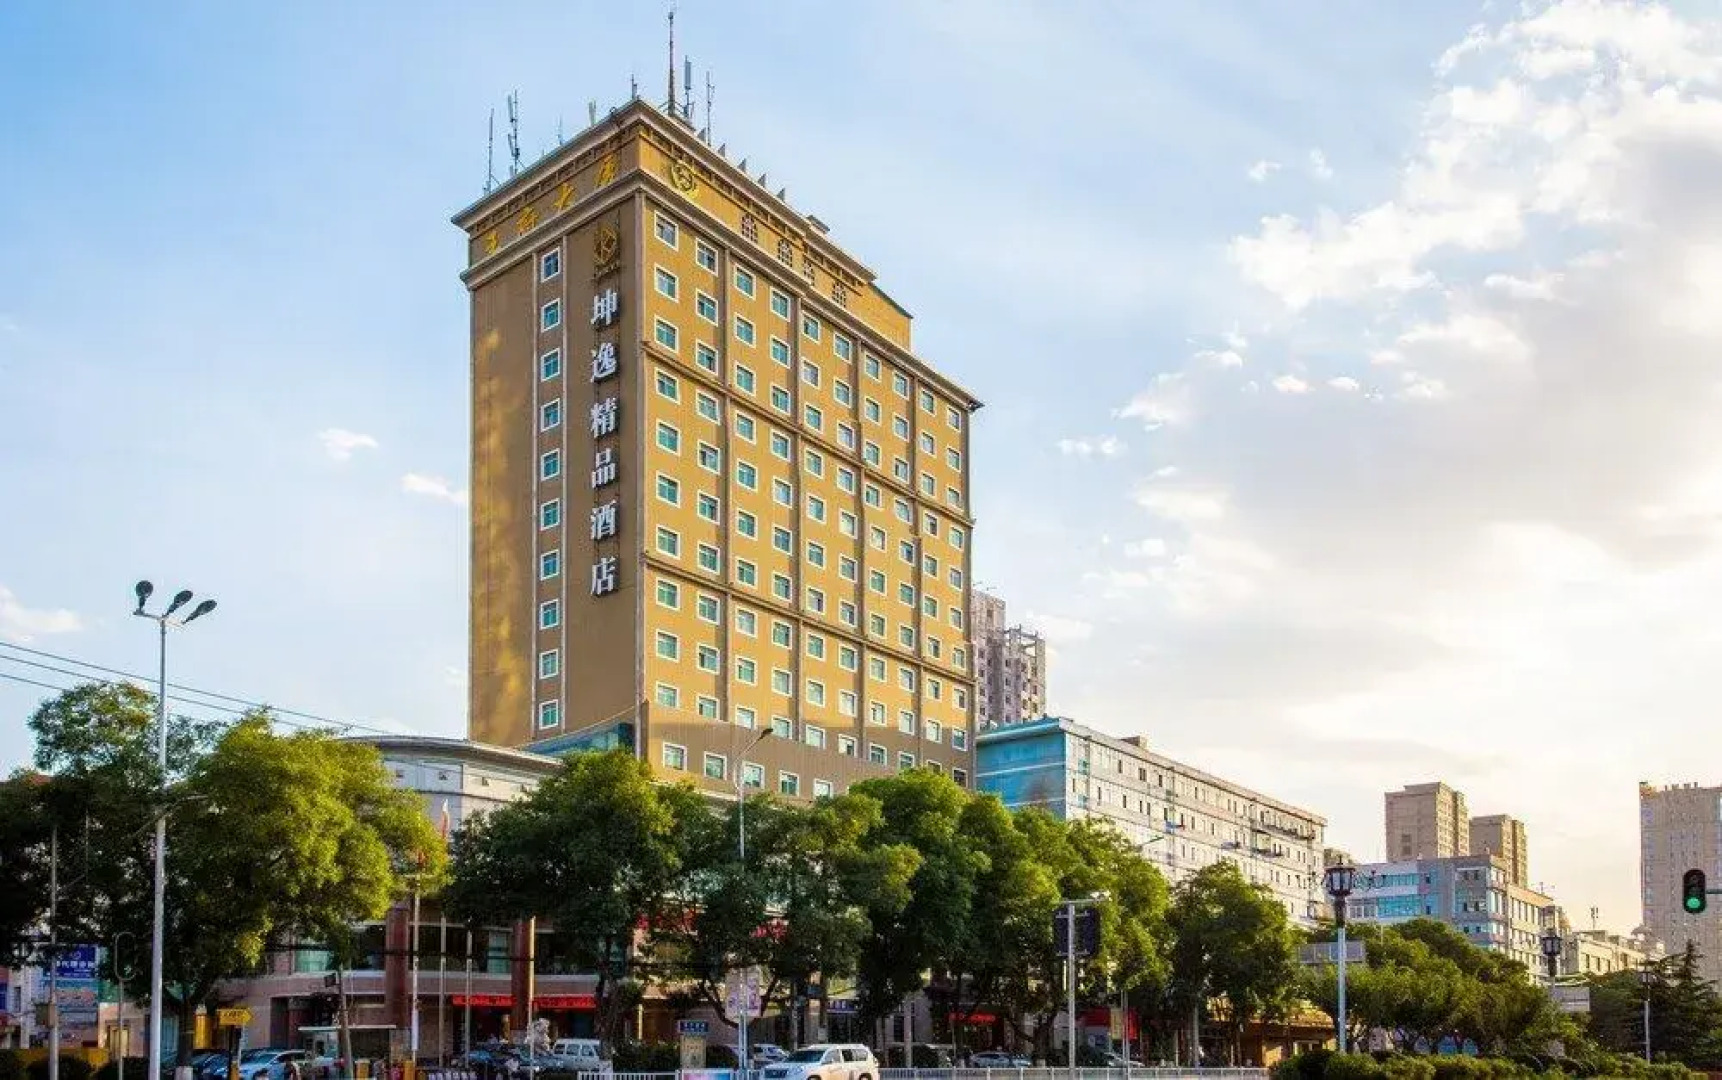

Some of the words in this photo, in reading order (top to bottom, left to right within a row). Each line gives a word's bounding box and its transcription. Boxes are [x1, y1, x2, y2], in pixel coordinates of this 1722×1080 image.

[590, 289, 619, 596] 坤逸精品酒店
